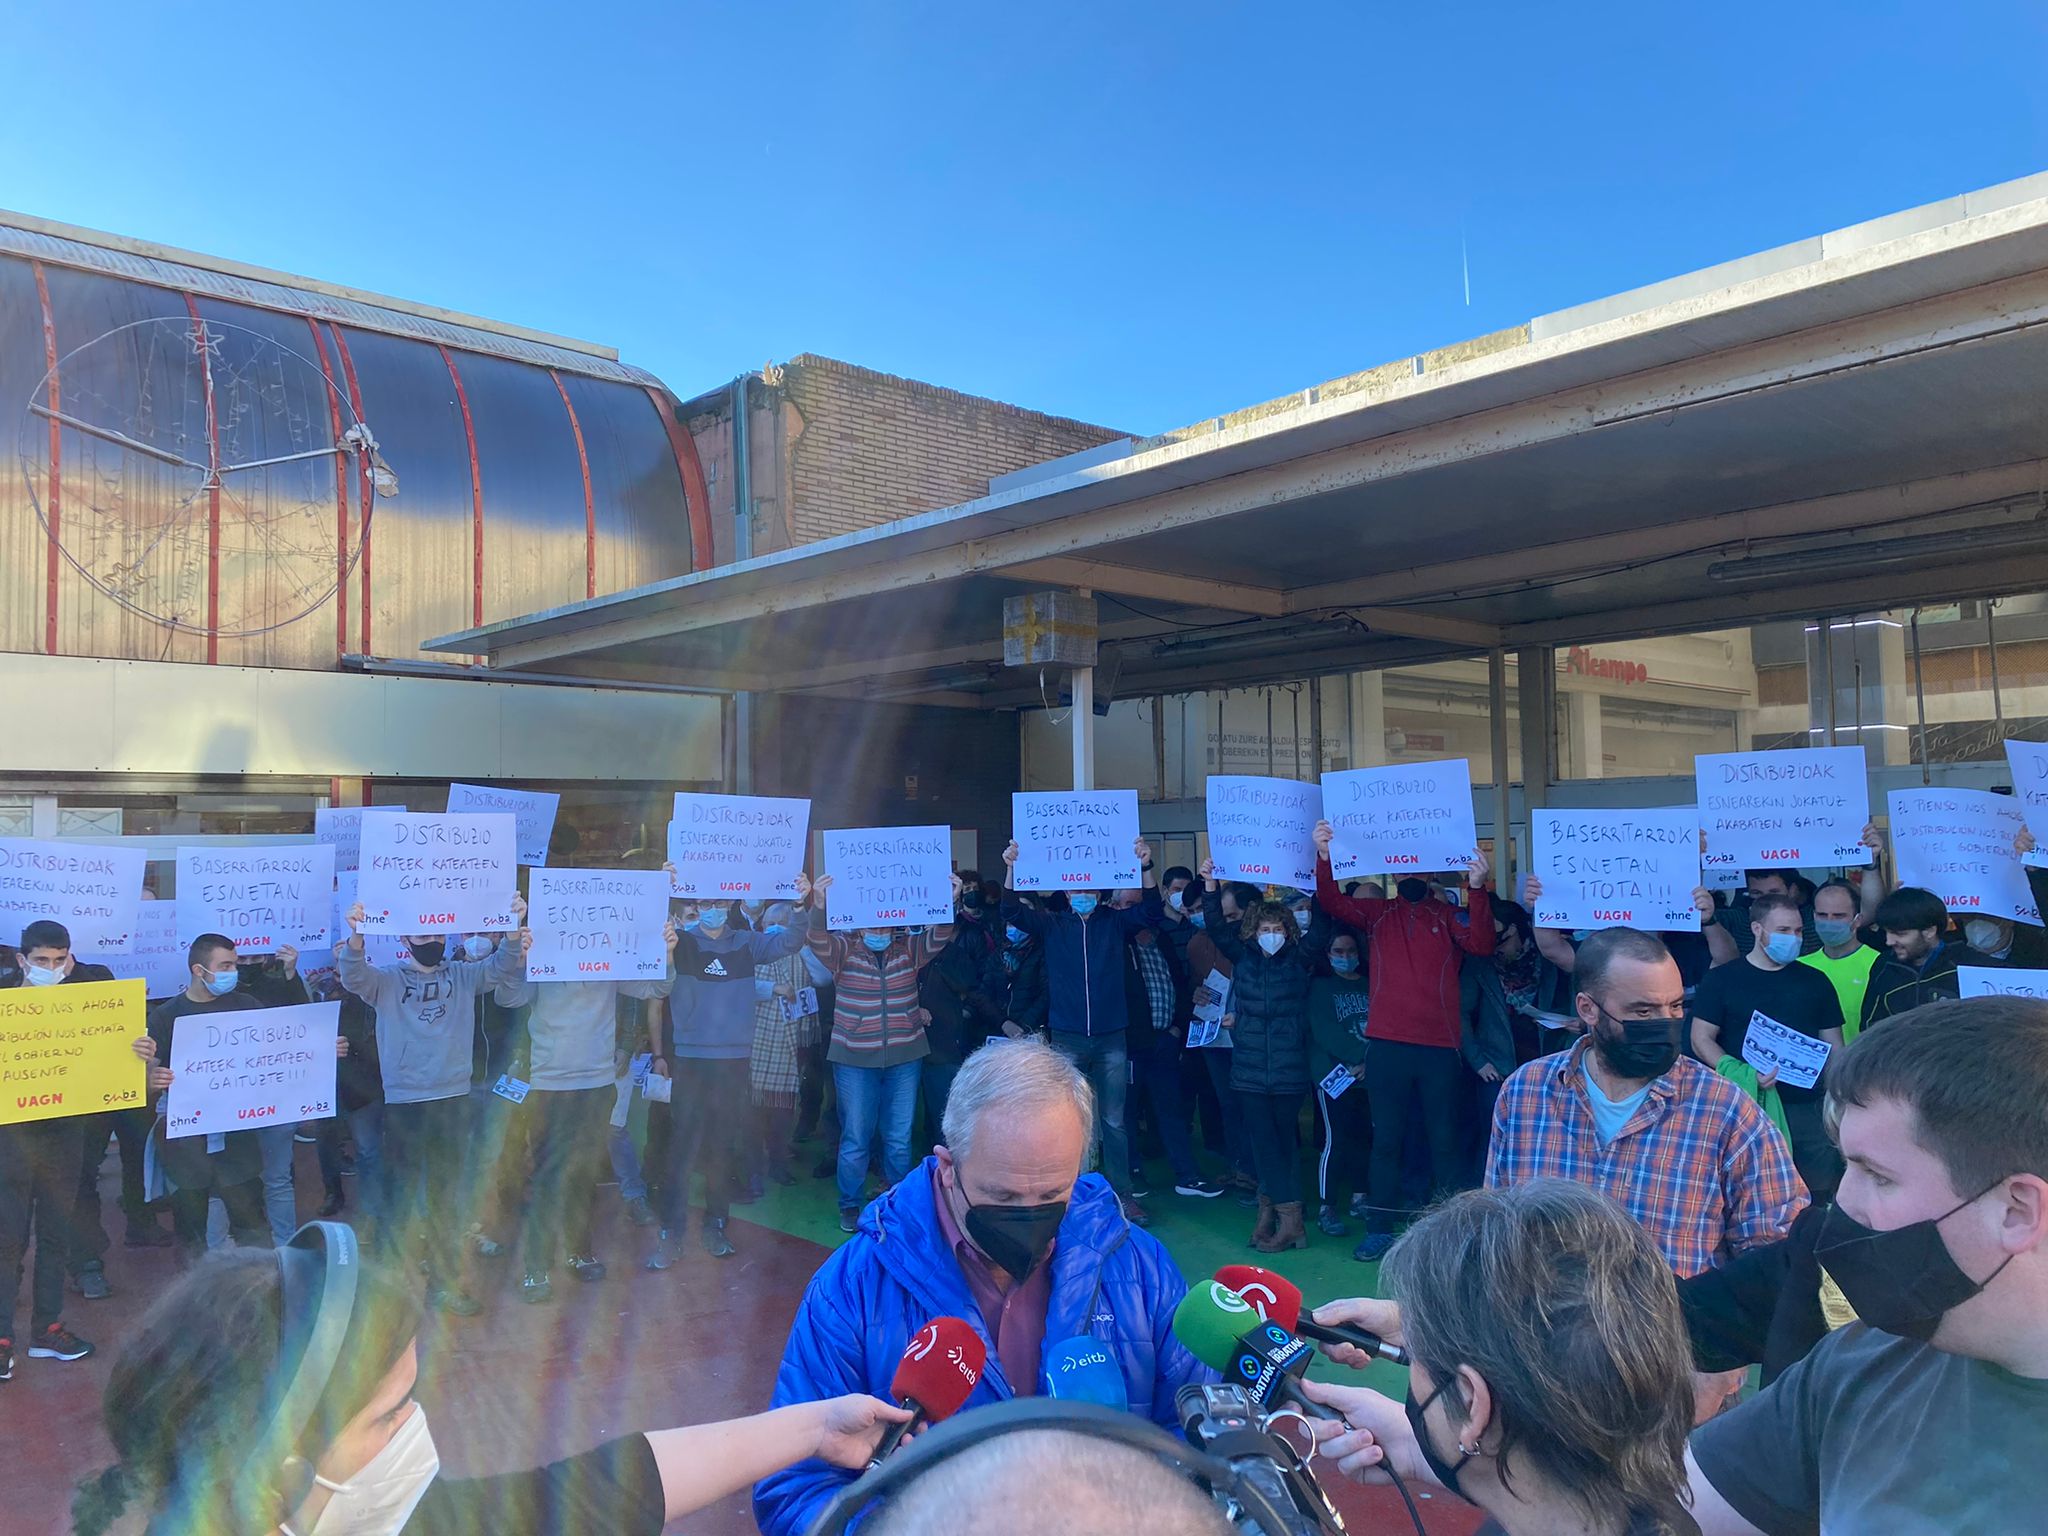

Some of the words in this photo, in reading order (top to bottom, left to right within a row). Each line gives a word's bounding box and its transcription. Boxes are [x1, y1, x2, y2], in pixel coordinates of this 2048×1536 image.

[1566, 645, 1647, 685] Alcampo
[1720, 762, 1835, 784] DISTRIBUZIOAK
[1217, 784, 1307, 812] DISTRIBUZIOAK
[1350, 779, 1436, 801] DISTRIBUZIO
[464, 790, 536, 812] DISTRIBUZIOAK
[1026, 800, 1120, 818] BASERRITARROK
[1708, 796, 1785, 810] ESNEAREKIN
[1790, 794, 1849, 809] JOKATUZ
[692, 803, 793, 829] DISTRIBUZIOAK
[1332, 813, 1377, 828] KATEEK
[1387, 808, 1451, 822] KATEATZEN
[1916, 799, 1958, 811] PIENSO
[1965, 803, 1986, 813] NOS
[1997, 808, 2024, 822] AHOG
[1031, 823, 1110, 840] ESNETAN
[1264, 816, 1307, 834] JOKATUZ
[1549, 820, 1692, 845] BASERRITARROK
[1716, 818, 1783, 832] AKABATZEN
[1793, 817, 1835, 828] GAITU
[1979, 829, 1996, 838] NOS
[394, 823, 492, 845] DISTRIBUZIO
[680, 830, 749, 847] ESNEAREKIN
[752, 835, 793, 849] JOKATUZ
[837, 838, 943, 858] BASERRITARROK
[1273, 839, 1304, 853] GAITU
[1761, 849, 1800, 860] UAGN
[1834, 841, 1864, 858] ehne
[1933, 843, 1947, 853] EL
[1957, 842, 2017, 860] GOBIERNO
[190, 856, 312, 875] BASERRITARROK
[372, 855, 423, 871] KATEEK
[432, 857, 499, 870] KATEATZEN
[682, 850, 743, 863] AKABATZEN
[756, 853, 785, 864] GAITU
[1334, 855, 1357, 871] ehne
[1384, 854, 1419, 864] UAGN
[1553, 855, 1658, 875] ESNETAN
[848, 864, 922, 880] ESNETAN
[1062, 873, 1091, 882] UAGN
[1114, 868, 1136, 880] ehne
[1240, 863, 1270, 875] UAGN
[1294, 869, 1315, 882] ehne
[1930, 863, 1990, 875] AUSENTE
[59, 881, 120, 898] JOKATUZ
[203, 883, 299, 902] ESNETAN
[542, 877, 645, 896] BASERRITARROK
[720, 882, 751, 891] UAGN
[775, 879, 798, 893] ehne
[1943, 895, 1980, 906] UAGN
[72, 904, 113, 918] GAITU
[419, 913, 456, 925] UAGN
[548, 905, 634, 924] ESNETAN
[877, 909, 906, 919] UAGN
[927, 903, 948, 918] ehne
[1594, 910, 1632, 921] UAGN
[1665, 907, 1694, 923] ehne
[98, 934, 128, 949] ehne
[234, 936, 271, 947] UAGN
[300, 928, 325, 944] ehne
[578, 962, 610, 972] UAGN
[637, 957, 661, 974] ehne
[704, 968, 728, 976] adidas
[51, 1001, 73, 1014] NOS
[82, 998, 125, 1012] AHOGA
[56, 1026, 76, 1039] NOS
[80, 1024, 126, 1036] REMATA
[206, 1023, 307, 1048] DISTRIBUZIO
[14, 1046, 84, 1061] GOBIERNO
[185, 1058, 236, 1076] KATEEK
[245, 1051, 314, 1069] KATEATZEN
[3, 1065, 69, 1082] AUSENTE
[17, 1092, 63, 1108] UAGN
[170, 1110, 201, 1131] ehne
[238, 1105, 276, 1119] UAGN
[1078, 1351, 1106, 1367] eitb
[1271, 1337, 1305, 1364] IRRATIAK
[958, 1361, 977, 1386] eitb
